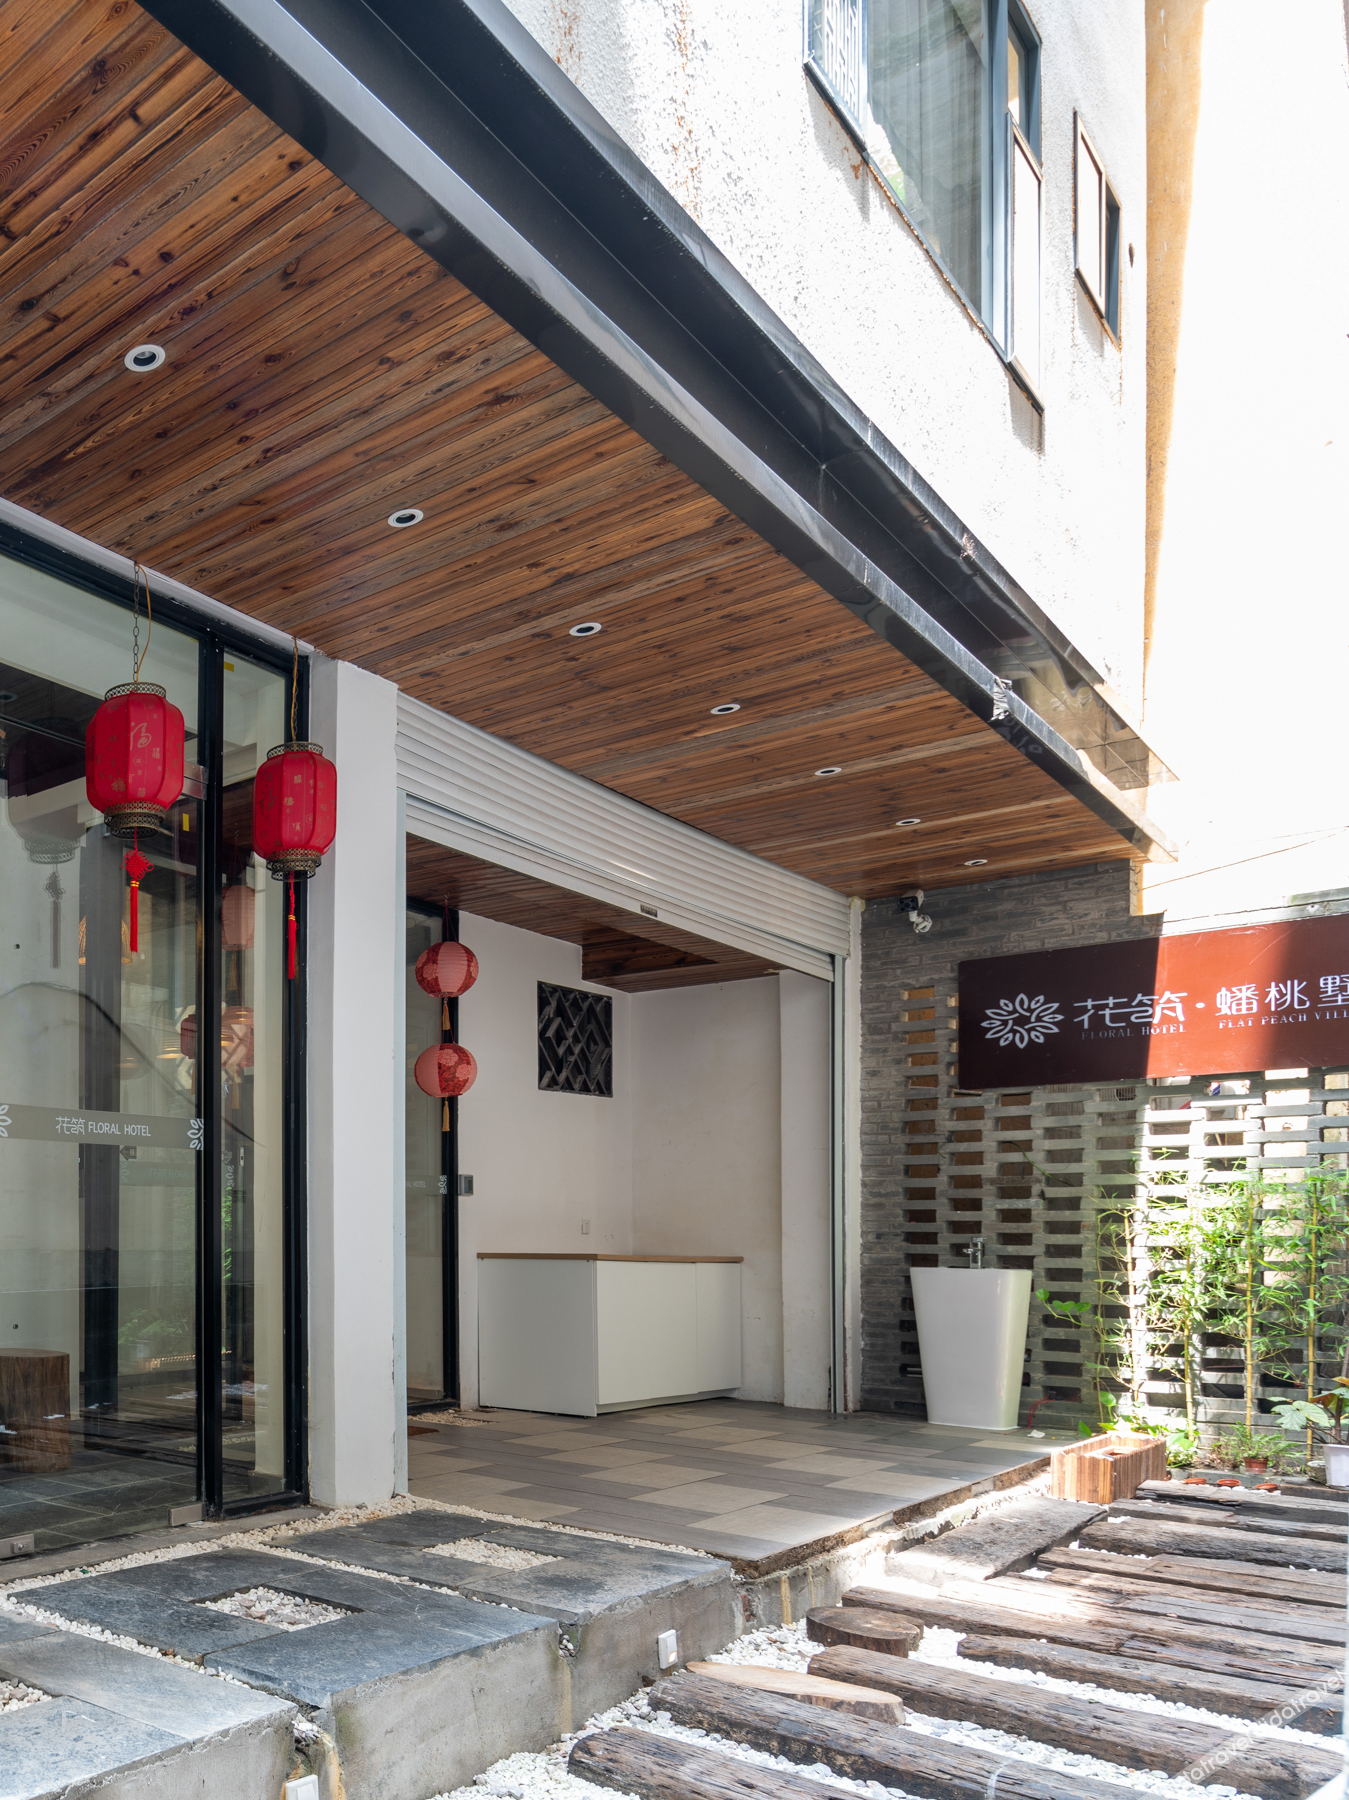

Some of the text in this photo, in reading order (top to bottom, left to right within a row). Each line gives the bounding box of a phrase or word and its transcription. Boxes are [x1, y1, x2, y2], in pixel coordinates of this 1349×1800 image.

[1218, 1017, 1254, 1029] FLAT
[1261, 1013, 1307, 1025] PEACH
[1081, 1024, 1187, 1040] FLORAL HOTEL
[55, 1116, 152, 1137] 花筑 FLORAL HOTEL
